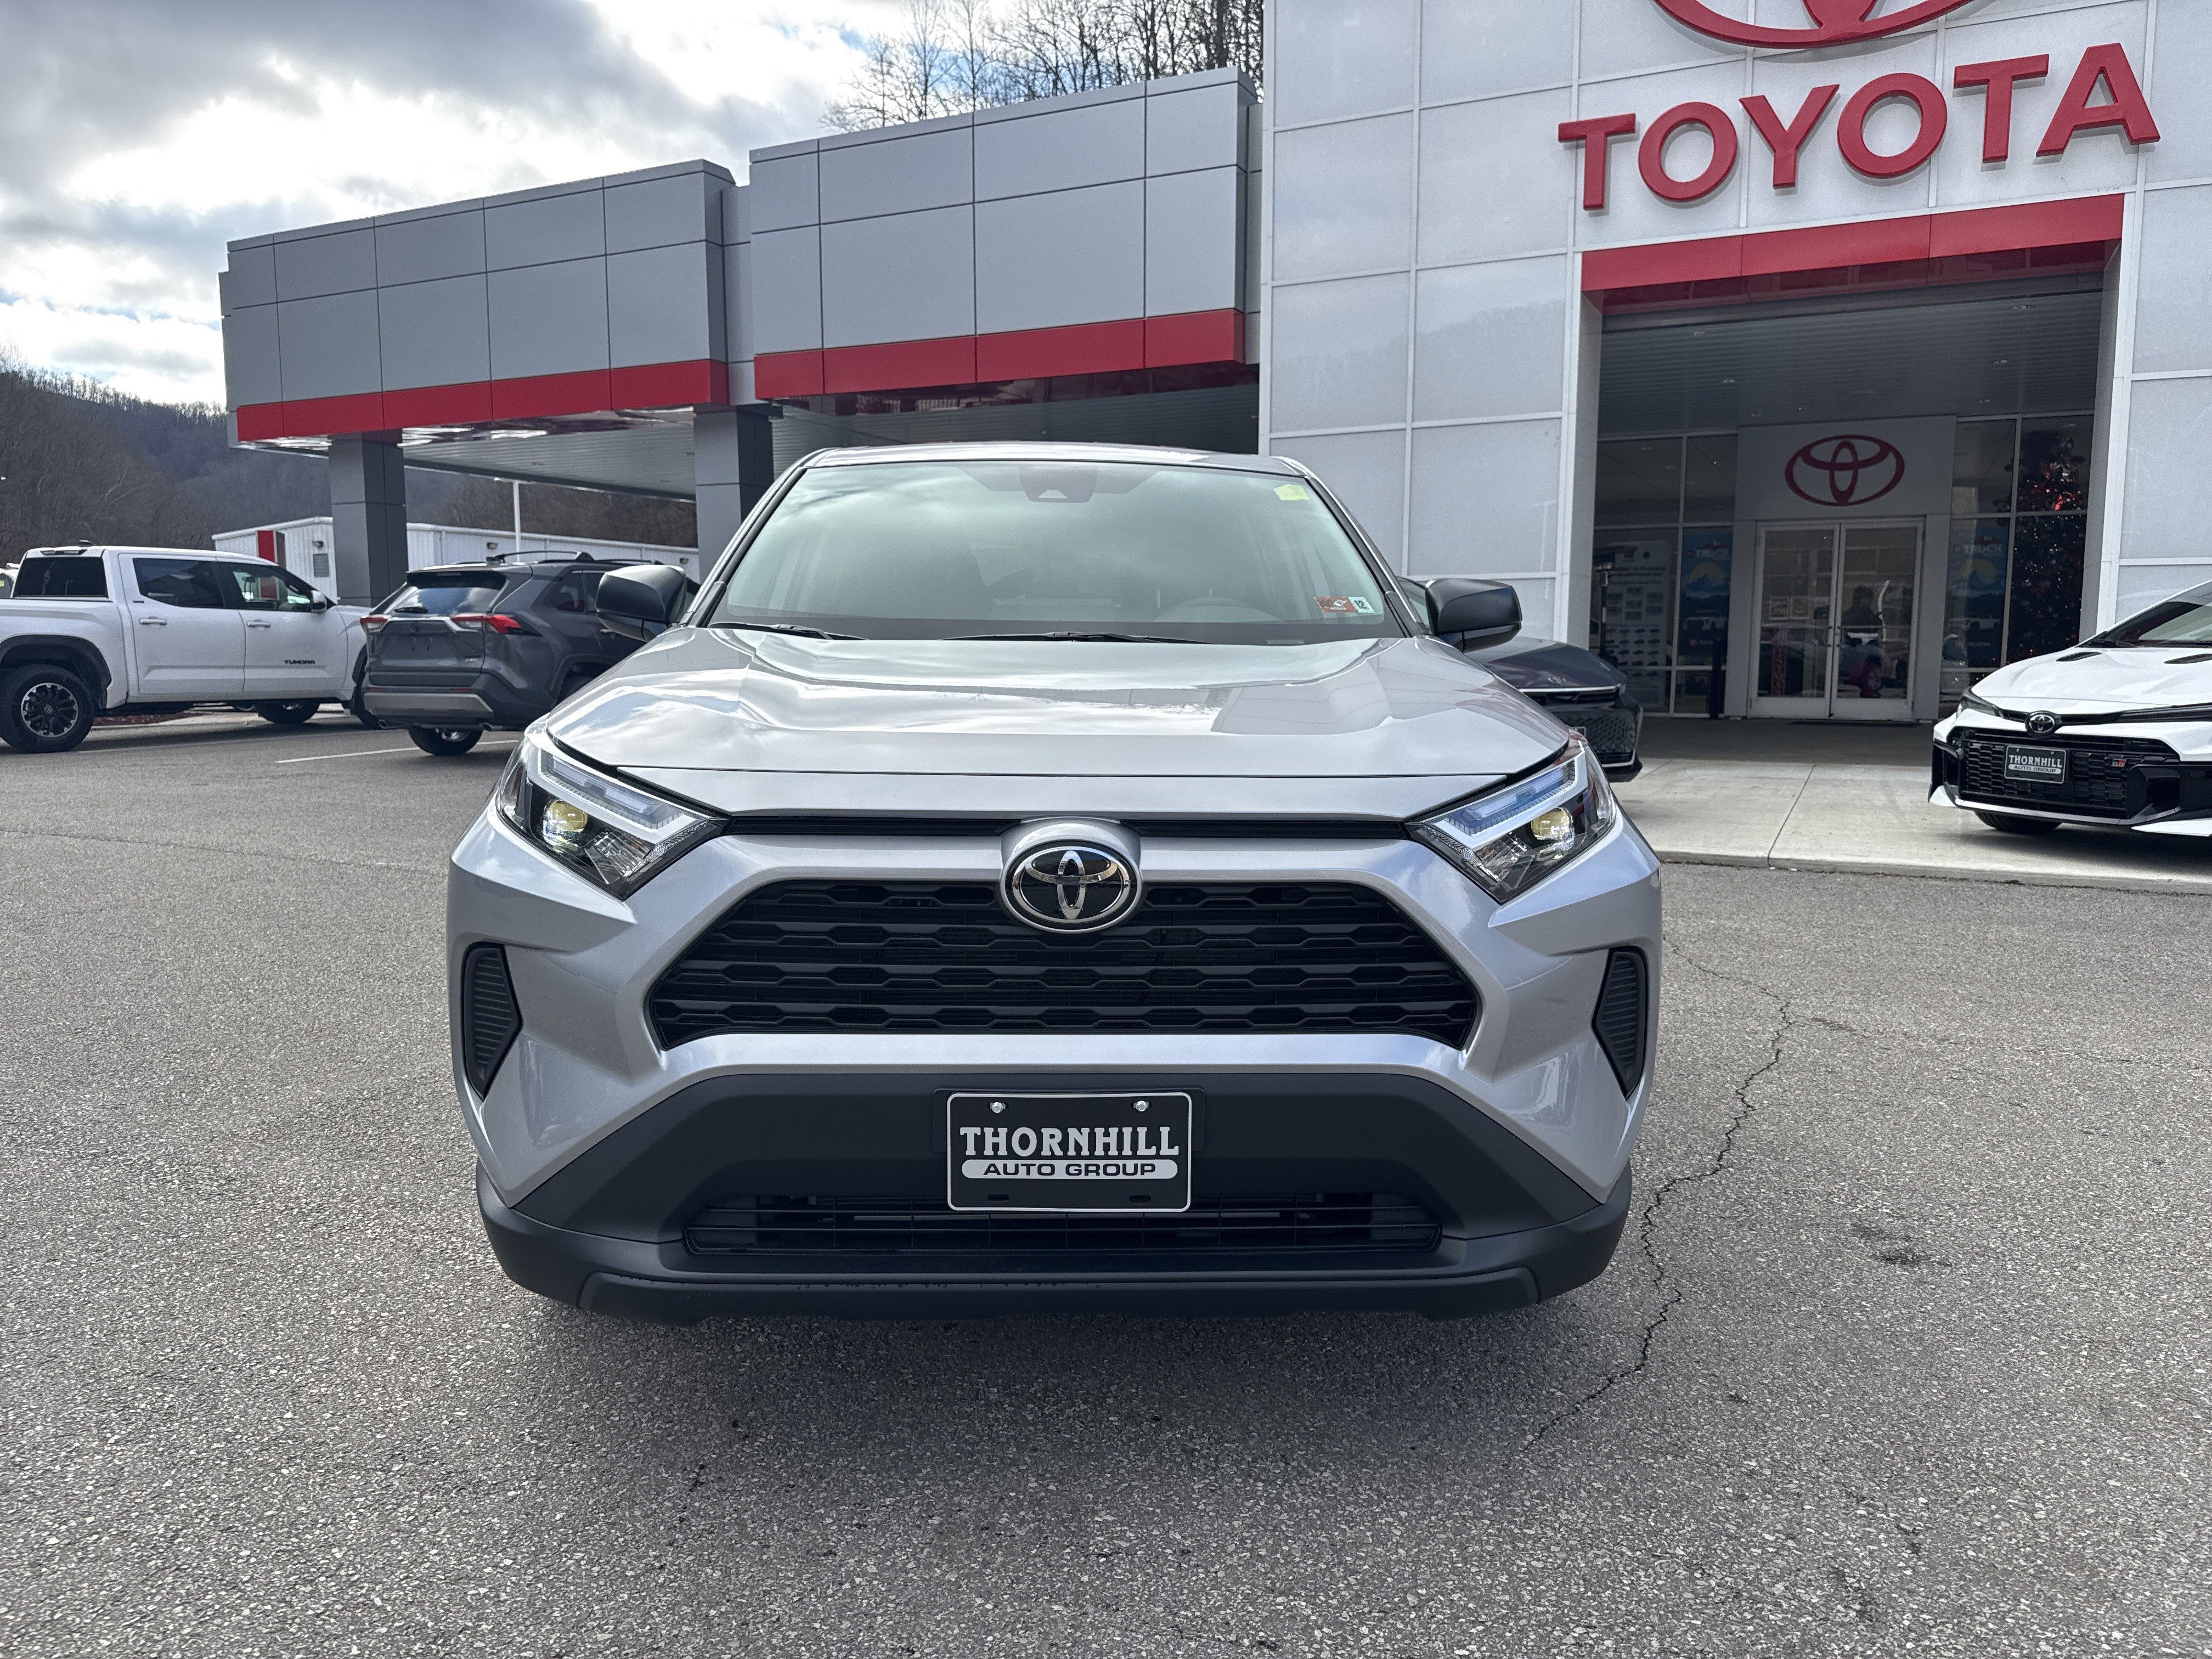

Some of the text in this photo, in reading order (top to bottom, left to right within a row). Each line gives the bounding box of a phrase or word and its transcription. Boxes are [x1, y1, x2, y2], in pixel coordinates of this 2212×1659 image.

[1558, 42, 2161, 211] TOYOTA
[1353, 600, 1368, 609] 12
[2008, 755, 2062, 768] THORNHILL
[960, 1126, 1179, 1157] THORNHILL
[983, 1163, 1156, 1176] AUTO GROUP
